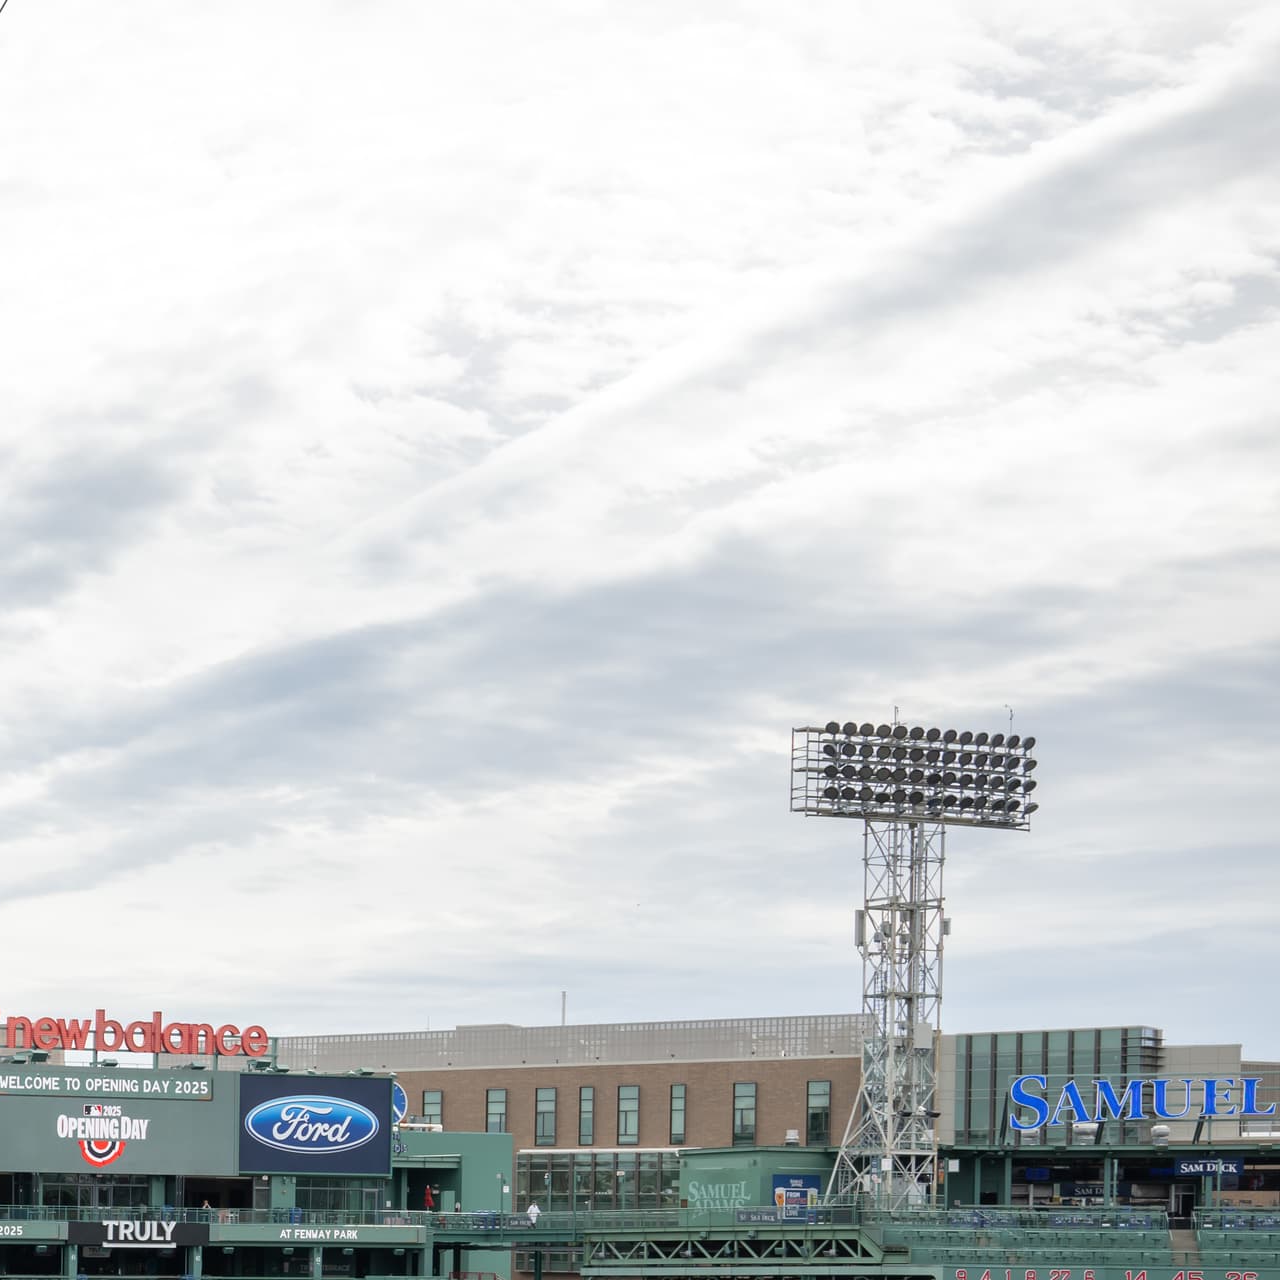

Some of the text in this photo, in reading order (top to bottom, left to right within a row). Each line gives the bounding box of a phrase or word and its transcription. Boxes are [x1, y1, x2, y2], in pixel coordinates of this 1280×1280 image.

[0, 1075, 209, 1095] WELCOME TO OPENING DAY 2025
[103, 1105, 122, 1117] 2025
[1009, 1074, 1277, 1131] SAMUEL
[56, 1114, 149, 1140] OPENING DAY
[272, 1103, 353, 1143] Ford
[1180, 1163, 1238, 1174] SAM DCK
[687, 1181, 752, 1201] SAMUEL
[102, 1220, 177, 1242] TRULY
[280, 1229, 358, 1240] AT FENWAY PARK
